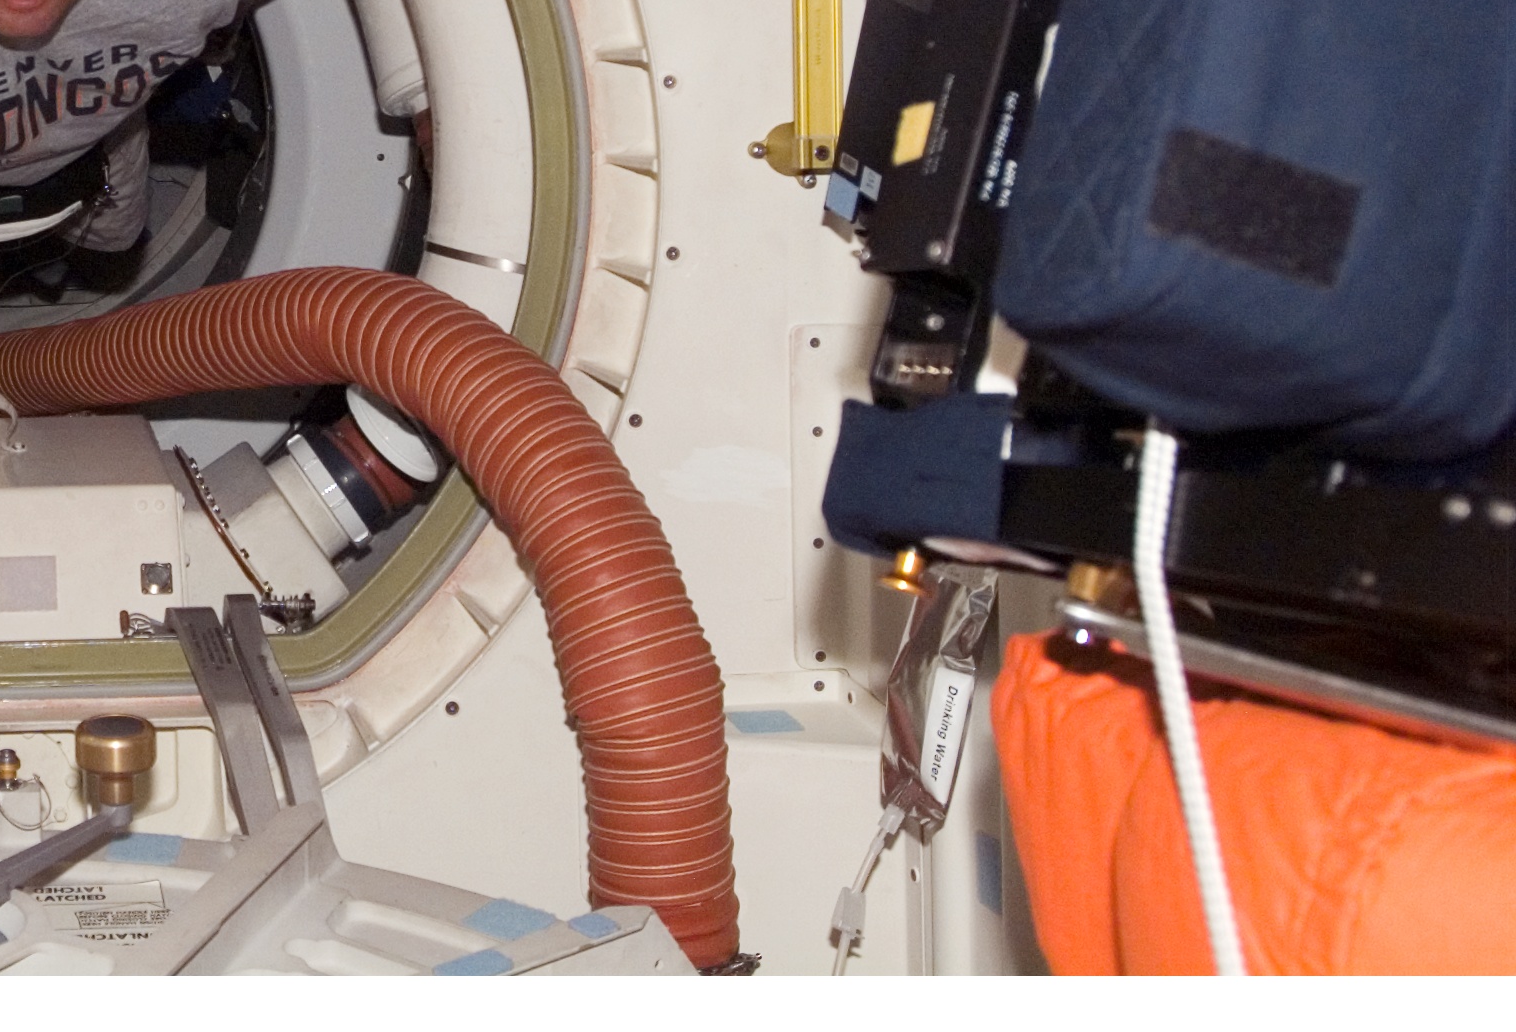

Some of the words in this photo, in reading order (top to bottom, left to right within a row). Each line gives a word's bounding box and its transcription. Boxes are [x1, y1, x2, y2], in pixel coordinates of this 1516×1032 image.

[937, 685, 959, 740] Drinking
[930, 744, 946, 782] Water
[35, 894, 107, 903] LATCHED
